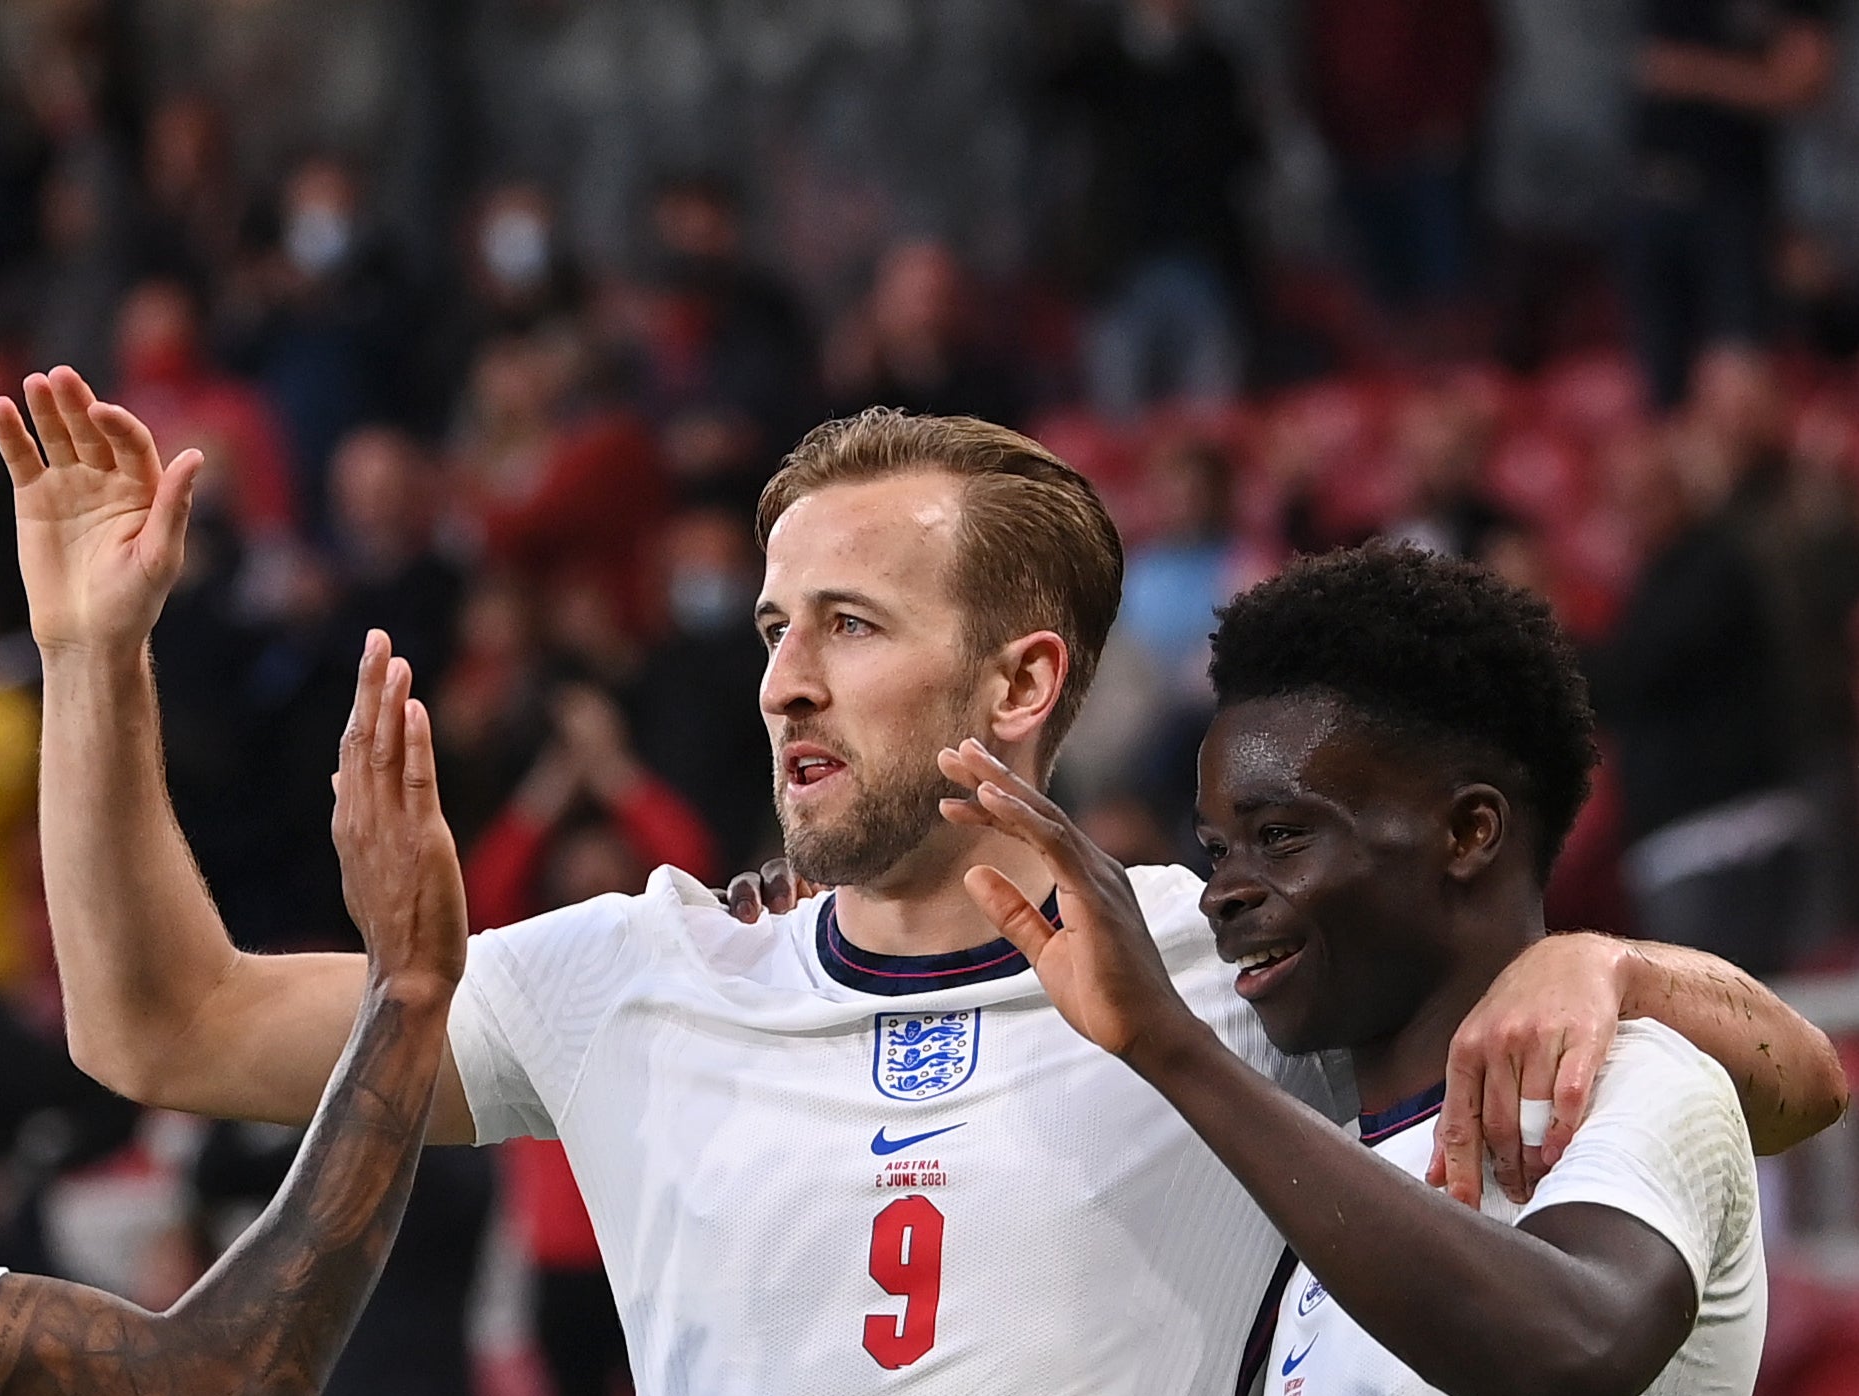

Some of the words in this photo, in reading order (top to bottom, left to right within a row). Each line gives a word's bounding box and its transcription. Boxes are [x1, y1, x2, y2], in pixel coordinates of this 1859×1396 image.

[884, 1159, 940, 1171] AUSTRIA
[875, 1174, 882, 1188] 2
[886, 1173, 917, 1187] JUNE
[921, 1172, 946, 1186] 2021
[862, 1194, 945, 1371] 9
